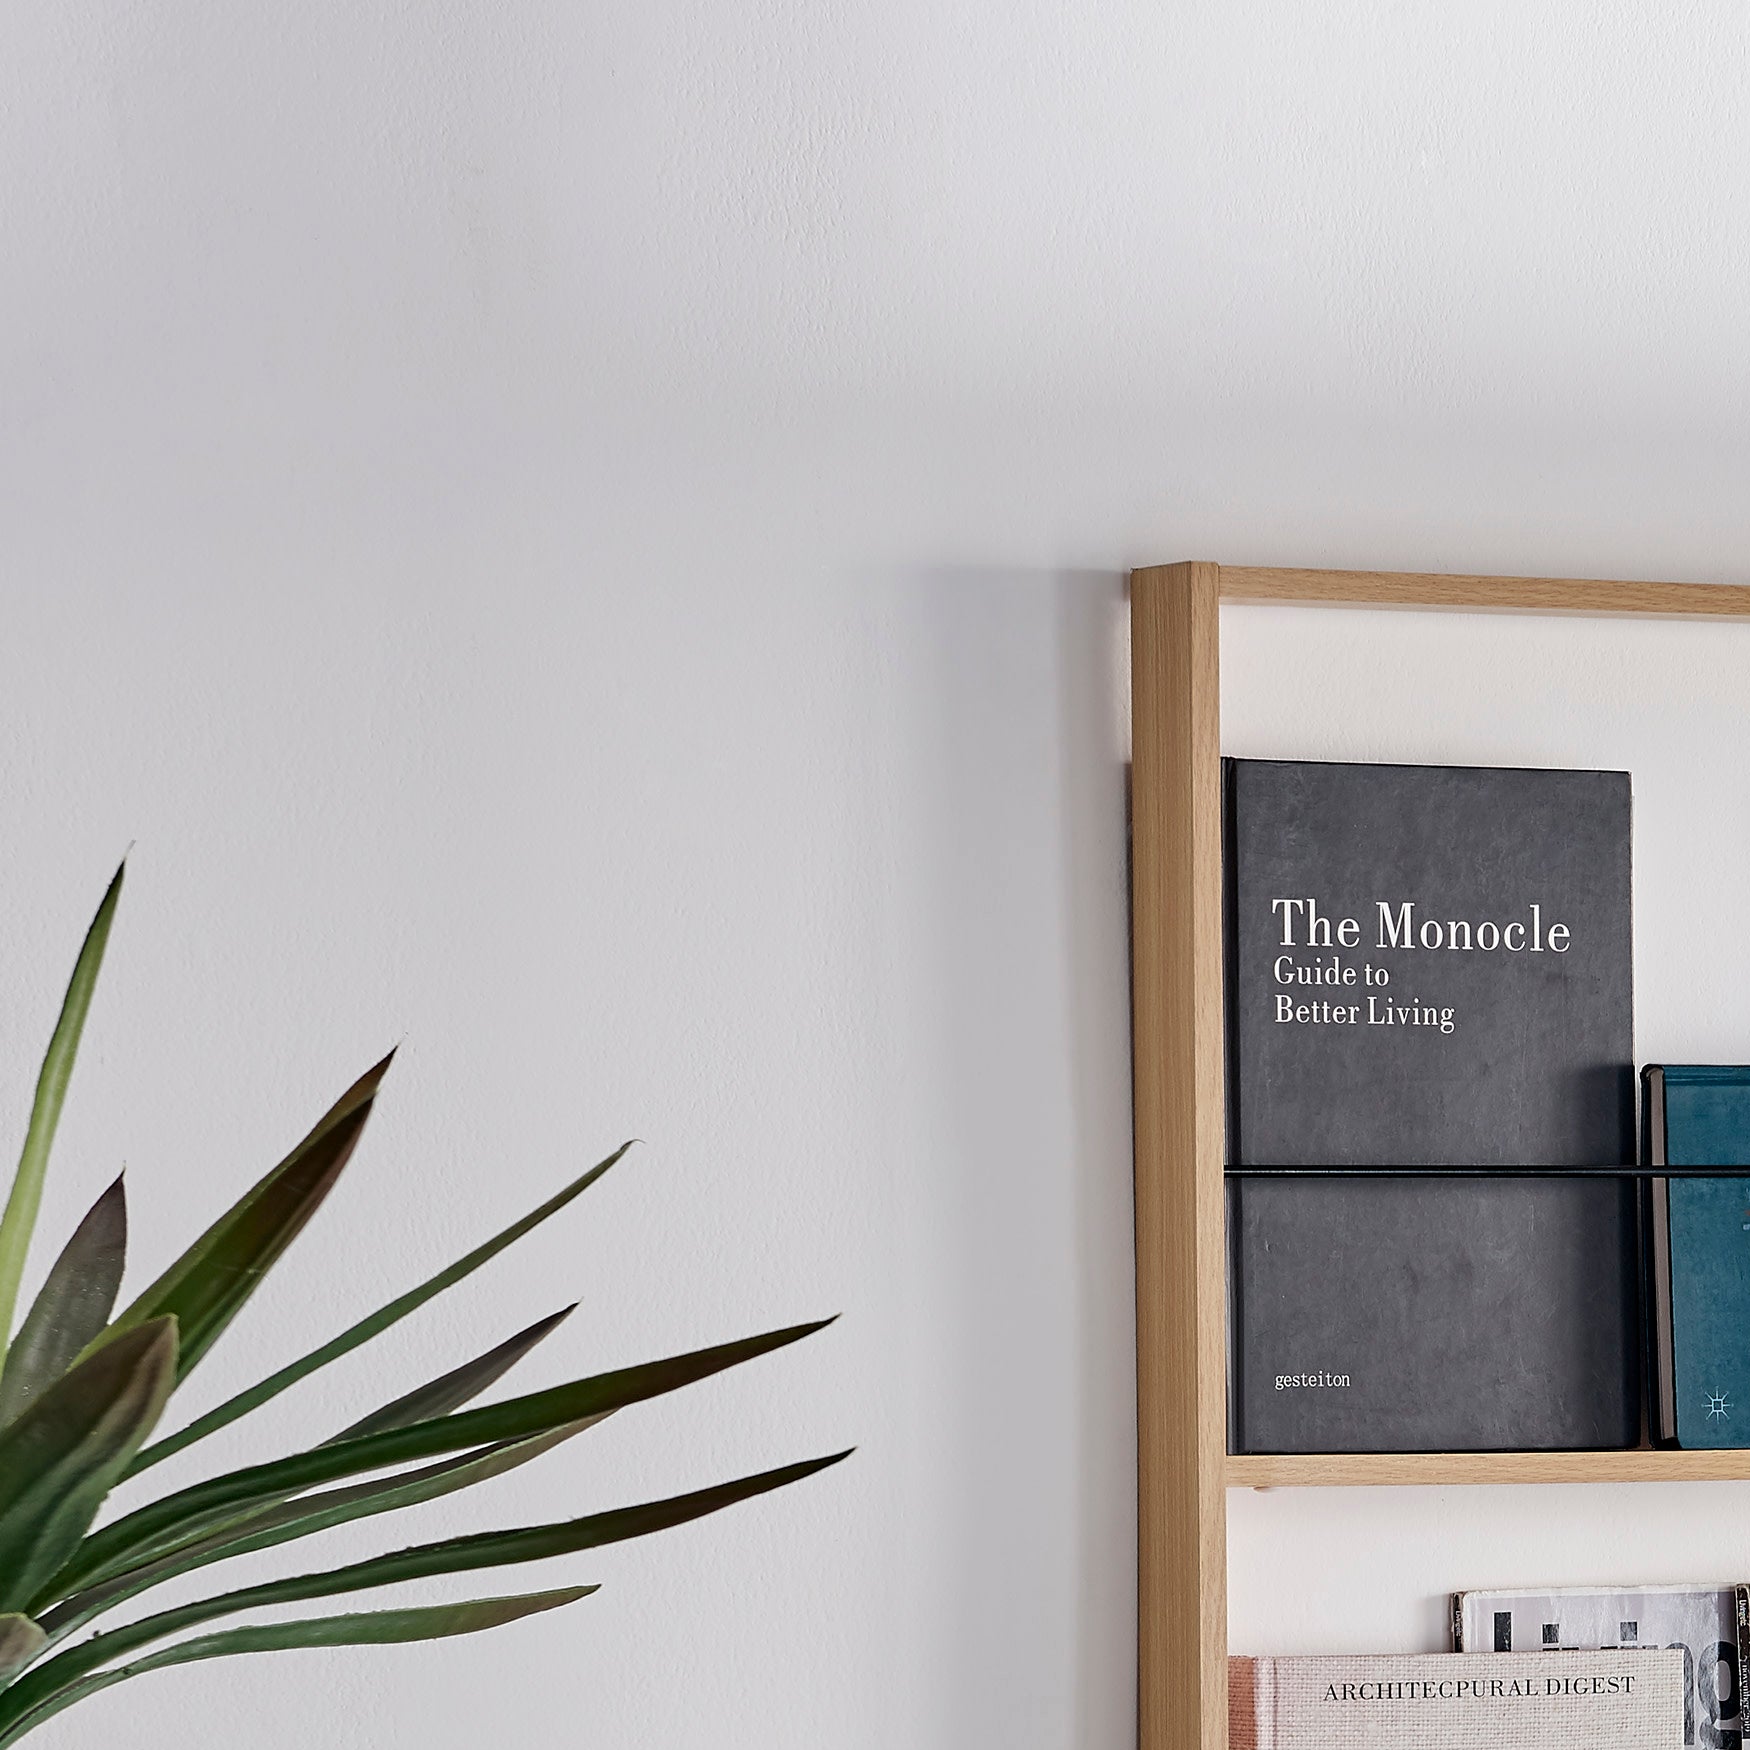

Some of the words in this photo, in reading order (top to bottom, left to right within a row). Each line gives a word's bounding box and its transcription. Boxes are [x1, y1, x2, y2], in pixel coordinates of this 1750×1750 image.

[1271, 898, 1361, 948] The
[1375, 901, 1572, 953] Monocle
[1272, 955, 1358, 987] Guide
[1363, 962, 1391, 987] to
[1273, 993, 1361, 1025] Better
[1366, 996, 1456, 1034] Living
[1274, 1370, 1351, 1391] gesteiton
[1322, 1678, 1540, 1702] ARCHITECPURAL
[1545, 1676, 1636, 1697] DIGEST
